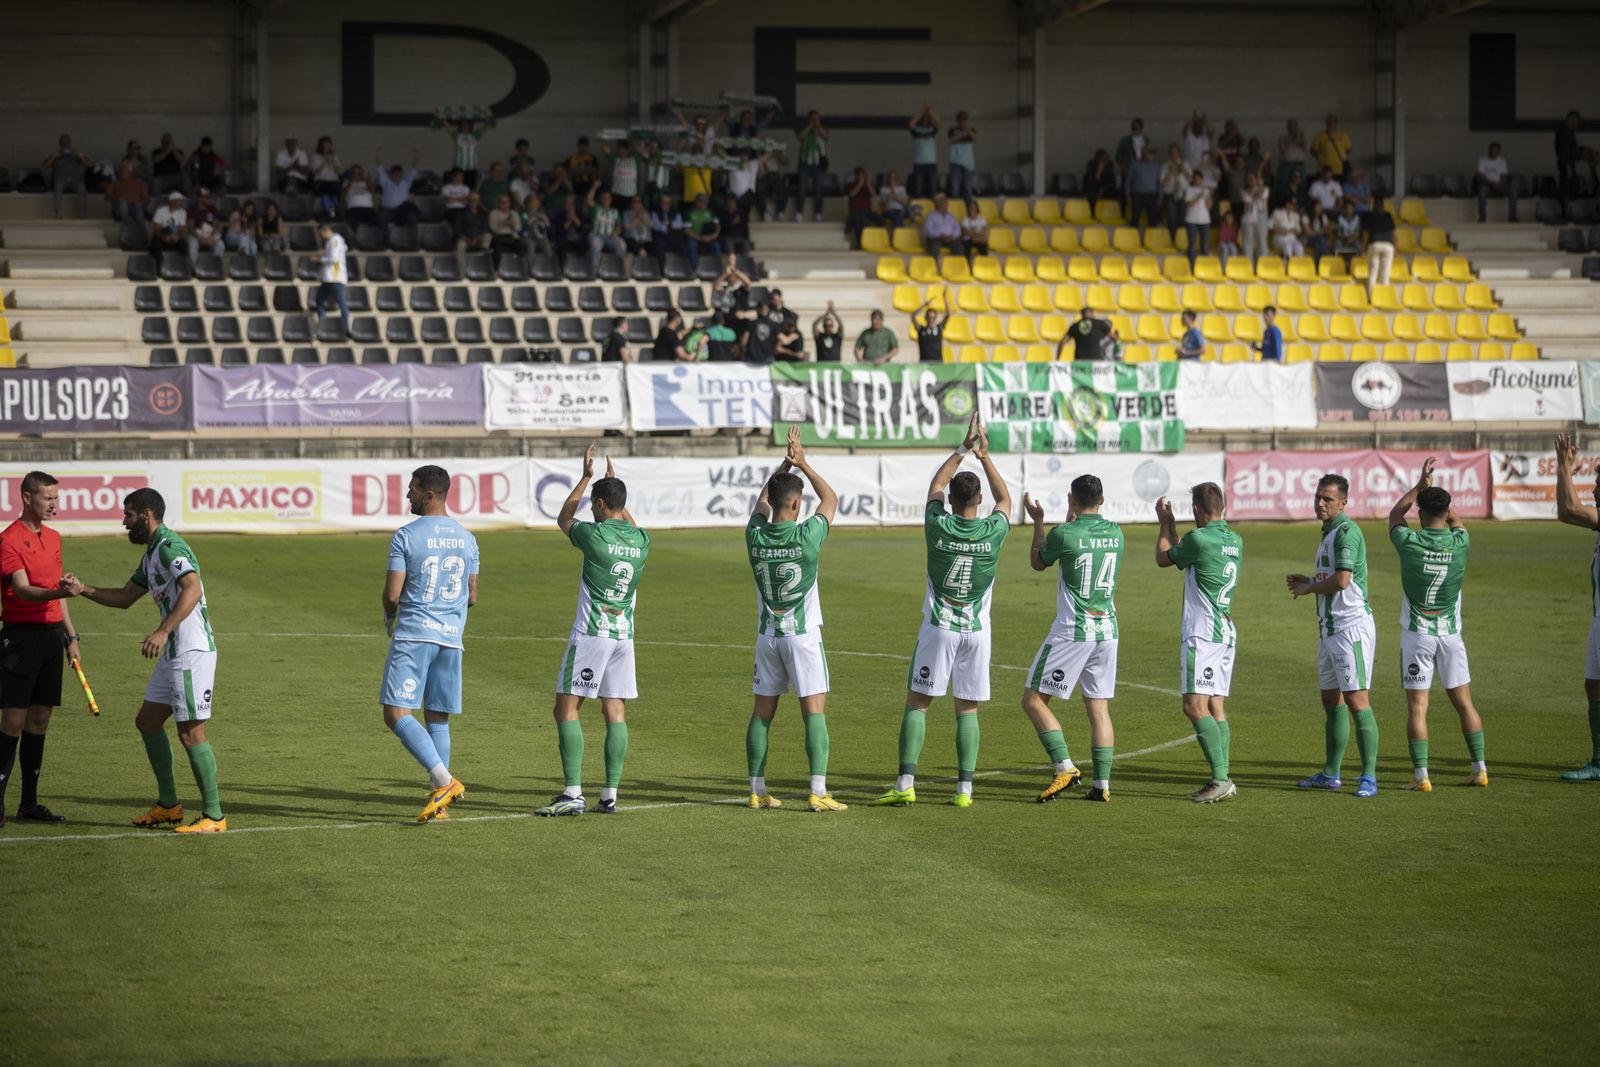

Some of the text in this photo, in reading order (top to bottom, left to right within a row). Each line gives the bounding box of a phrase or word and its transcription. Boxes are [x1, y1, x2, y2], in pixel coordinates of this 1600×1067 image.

[0, 377, 130, 421] PULSO23
[223, 377, 454, 401] Abuela María
[809, 368, 941, 440] ULTRAS
[990, 394, 1177, 418] MAREA VERDE
[192, 487, 315, 510] MAXICO
[427, 538, 465, 549] OLMEDO
[608, 542, 641, 558] VÍCTOR
[1090, 537, 1119, 548] VACAS
[421, 555, 466, 602] 13
[604, 561, 634, 601] 3
[755, 561, 802, 602] 12
[943, 554, 973, 598] 4
[1074, 552, 1118, 598] 14
[1217, 561, 1237, 607] 2
[1424, 563, 1449, 605] 7
